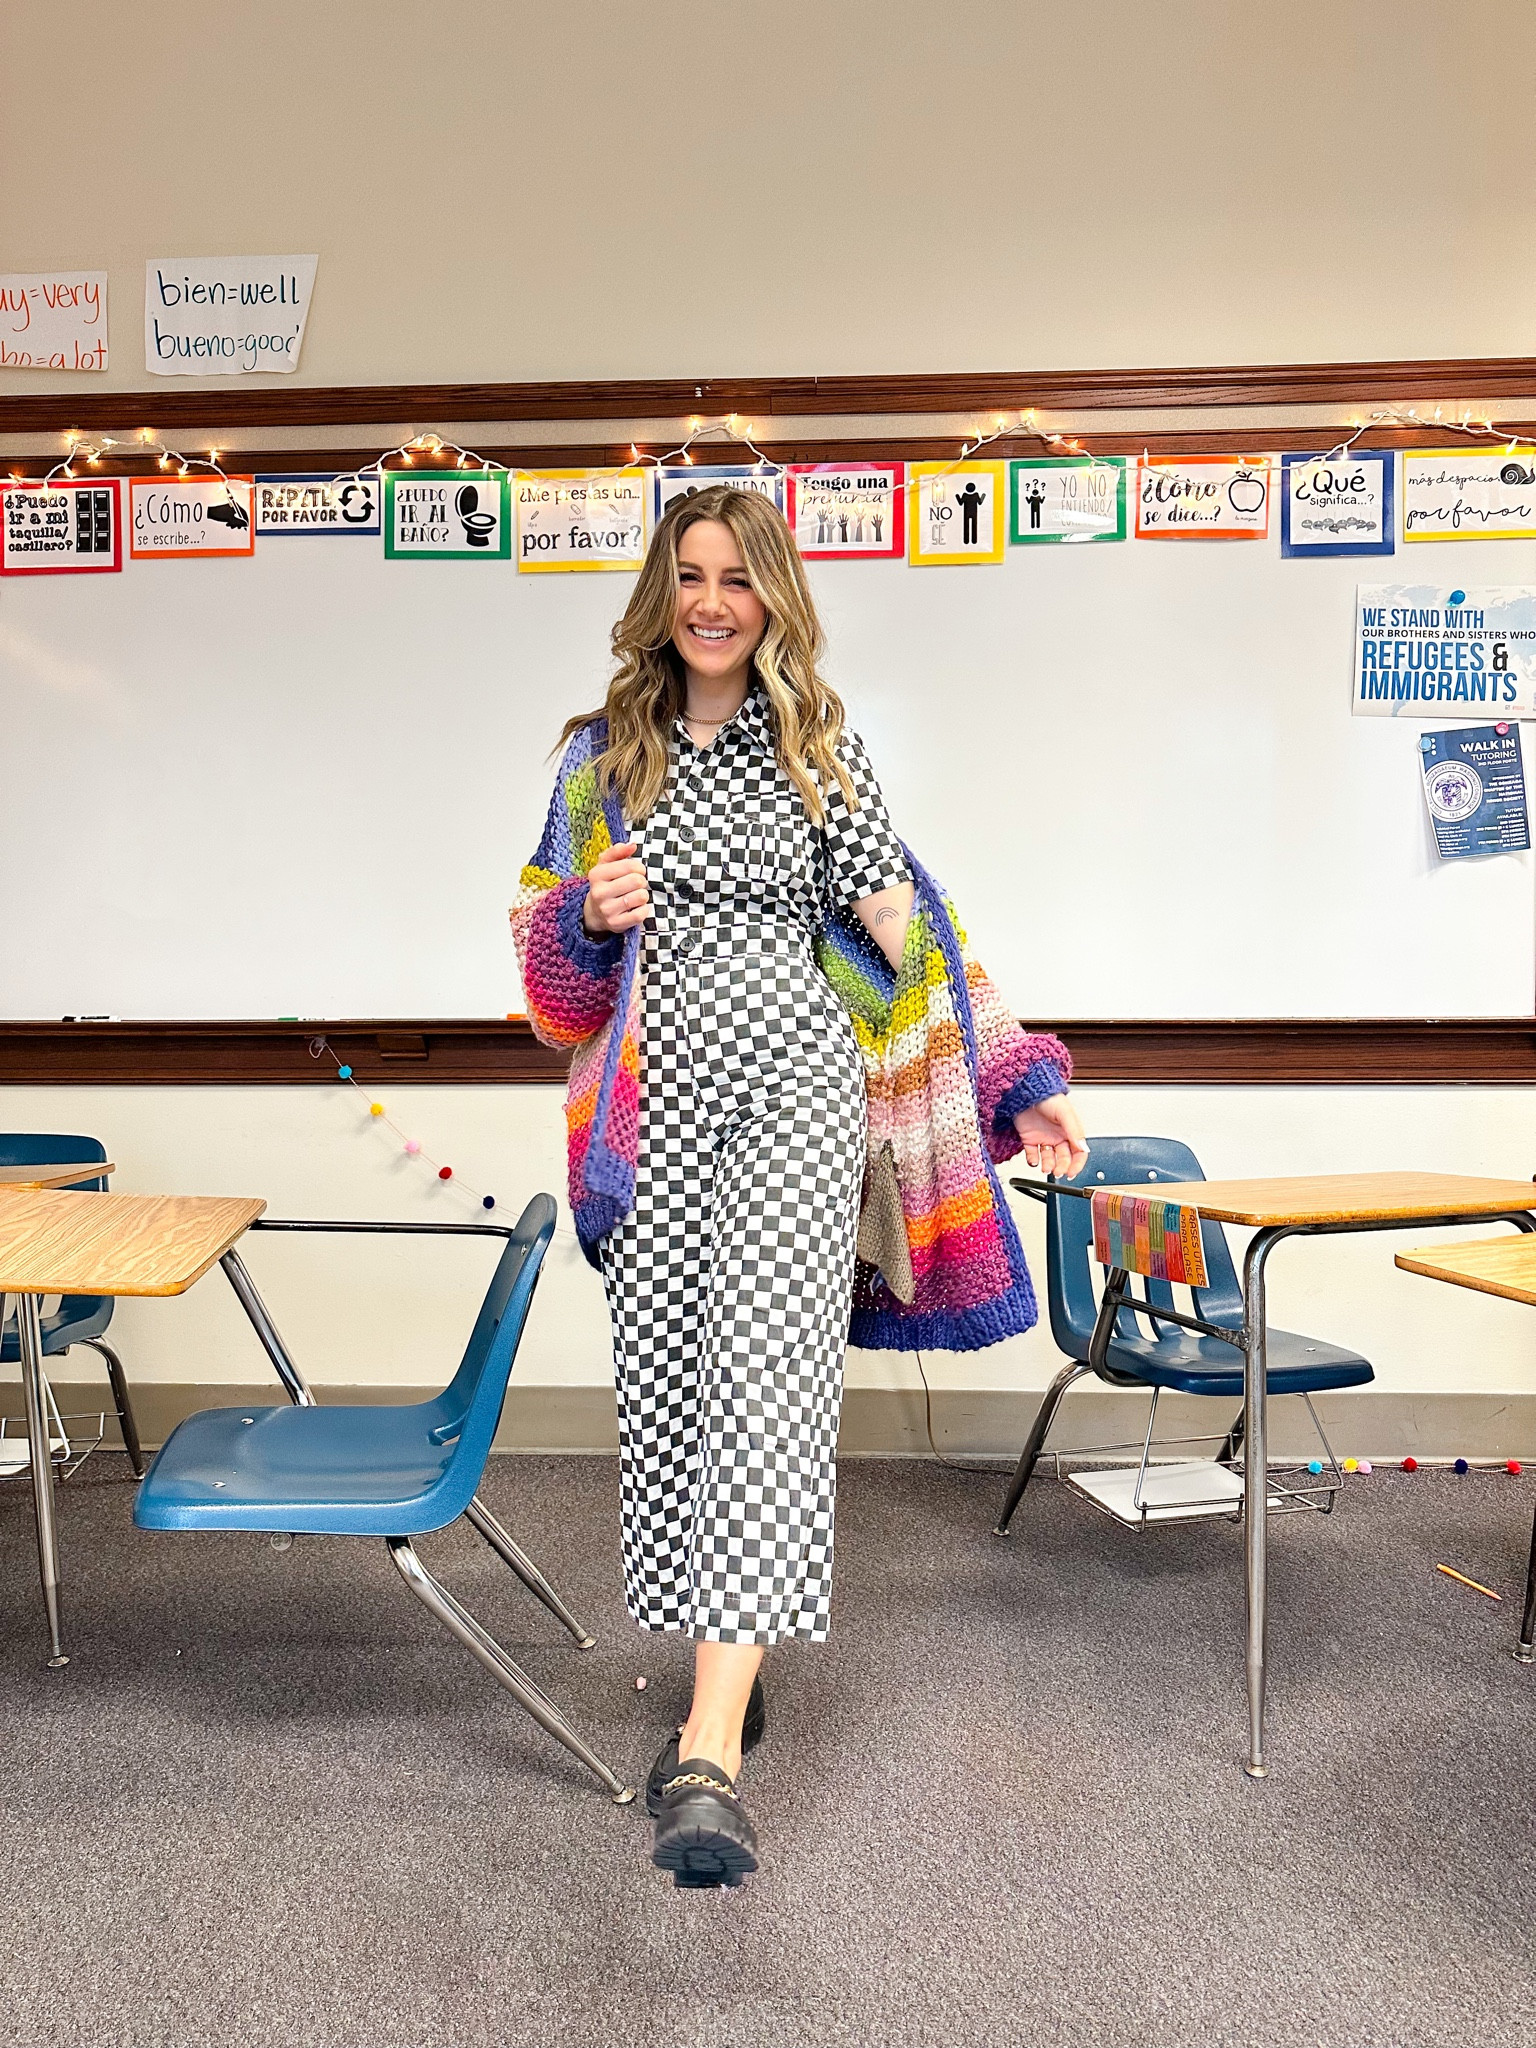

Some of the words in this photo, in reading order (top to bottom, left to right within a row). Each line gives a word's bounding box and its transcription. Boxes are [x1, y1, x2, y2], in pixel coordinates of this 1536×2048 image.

[156, 269, 300, 307] bien=well
[801, 476, 851, 491] Tengo
[857, 477, 889, 489] una
[1059, 474, 1077, 498] YO
[1087, 474, 1107, 498] NO
[1142, 474, 1217, 503] ¿Cómo
[1295, 468, 1366, 500] ¿Qué
[1408, 473, 1435, 486] más
[4, 493, 68, 509] ¿Puedo
[397, 488, 448, 502] ¿PUEDO
[519, 488, 550, 502] ¿Me
[9, 510, 25, 525] ir
[30, 512, 41, 524] a
[45, 510, 69, 524] mi
[135, 494, 203, 529] ¿Cómo
[262, 510, 289, 523] POR
[292, 509, 338, 522] FAVOR
[400, 504, 419, 523] IR
[929, 506, 953, 521] NO
[1144, 511, 1162, 525] se
[1167, 503, 1221, 523] dice...?
[1406, 507, 1450, 530] por
[1452, 499, 1532, 528] favor
[9, 526, 68, 540] taquilla/
[137, 535, 149, 545] se
[153, 531, 206, 545] escribe...?
[400, 523, 450, 543] BAÑO?
[522, 532, 561, 556] por
[568, 525, 642, 548] favor?
[8, 540, 73, 552] casillero?
[1362, 608, 1387, 627] WE
[1391, 608, 1440, 628] STAND
[1445, 609, 1484, 628] WITH
[1362, 628, 1384, 638] OUR
[1387, 629, 1440, 639] BROTHERS
[1442, 630, 1465, 639] AND
[1468, 630, 1507, 640] SISTERS
[1509, 631, 1536, 640] WHO
[1362, 640, 1485, 671] REFUGEES
[1492, 642, 1509, 672] &
[1360, 670, 1518, 702] IMMIGRANTS
[1460, 739, 1500, 753] WALK
[1501, 738, 1516, 749] IN
[1471, 750, 1517, 761] TUTORING
[1189, 1208, 1199, 1248] FRASES
[1183, 1246, 1193, 1279] CLASE
